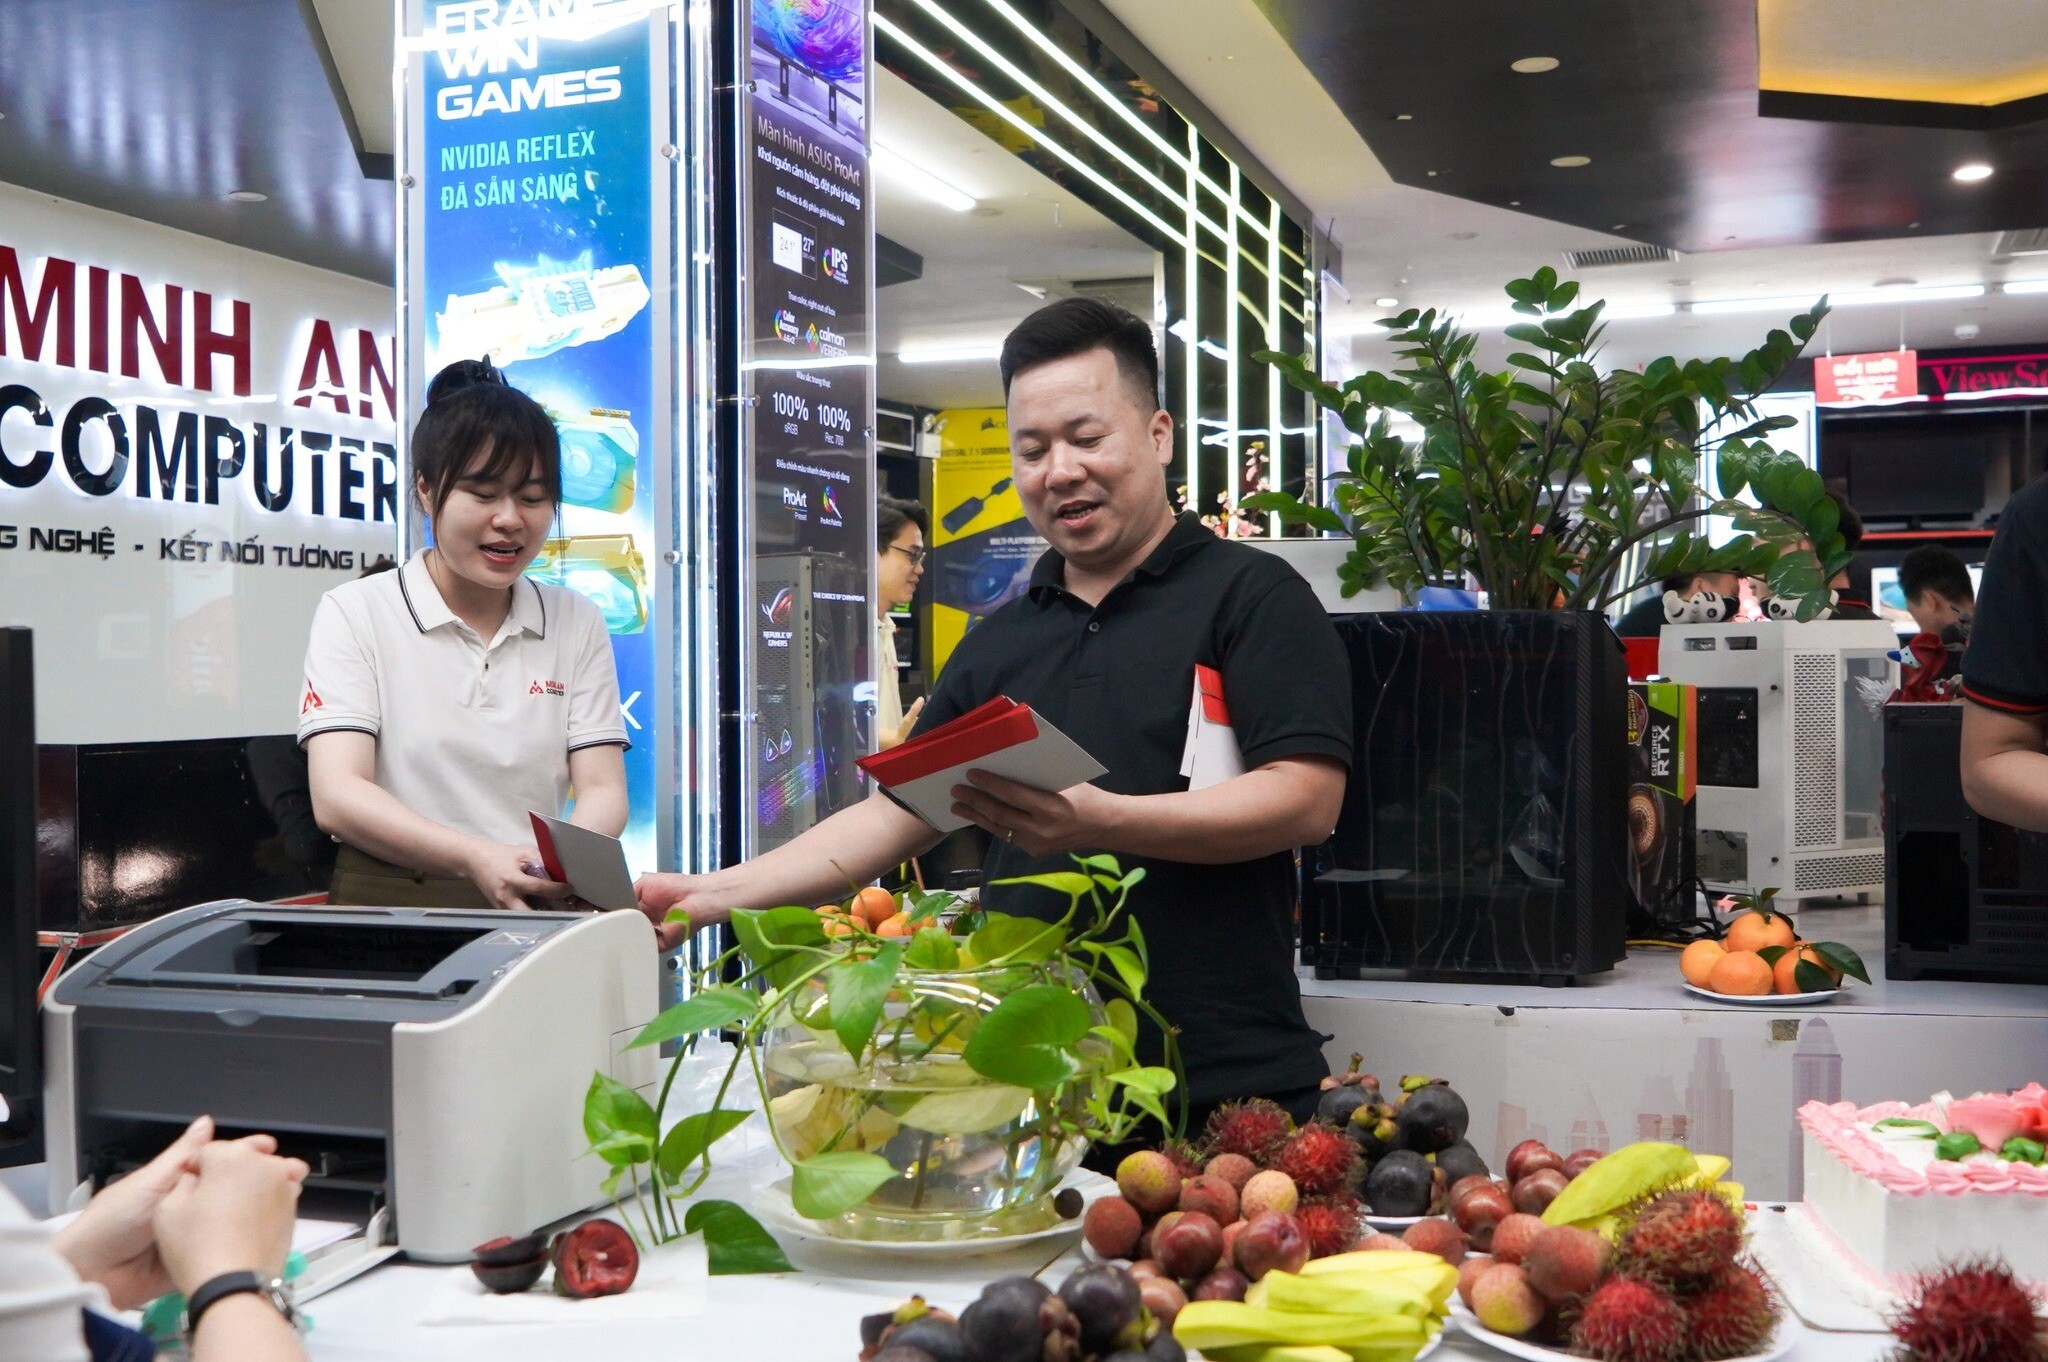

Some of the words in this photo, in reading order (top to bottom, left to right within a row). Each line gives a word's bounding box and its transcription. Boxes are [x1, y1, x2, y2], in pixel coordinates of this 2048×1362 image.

[436, 28, 538, 79] WIN
[436, 65, 622, 121] GAMES
[441, 140, 511, 172] NVIDIA
[516, 130, 596, 164] REFLEX
[758, 115, 781, 145] Màn
[783, 127, 806, 157] hình
[807, 142, 832, 172] ASUS
[834, 155, 860, 187] ProArt
[440, 181, 469, 211] ĐÃ
[521, 172, 578, 203] SÀNG
[831, 247, 849, 273] IPS
[0, 245, 251, 397] MINH
[294, 318, 397, 423] AN
[819, 326, 846, 348] calman
[772, 391, 809, 421] 100%
[817, 404, 851, 432] 100%
[784, 422, 799, 436] sRGB
[0, 383, 397, 523] COMPUTER
[783, 487, 807, 508] ProArt
[29, 525, 116, 560] NGHỆ
[160, 528, 213, 562] KẾT
[221, 534, 266, 564] NỐI
[273, 543, 354, 570] TƯƠNG
[1651, 725, 1659, 777] GEFORCE
[1657, 725, 1670, 777] RTX
